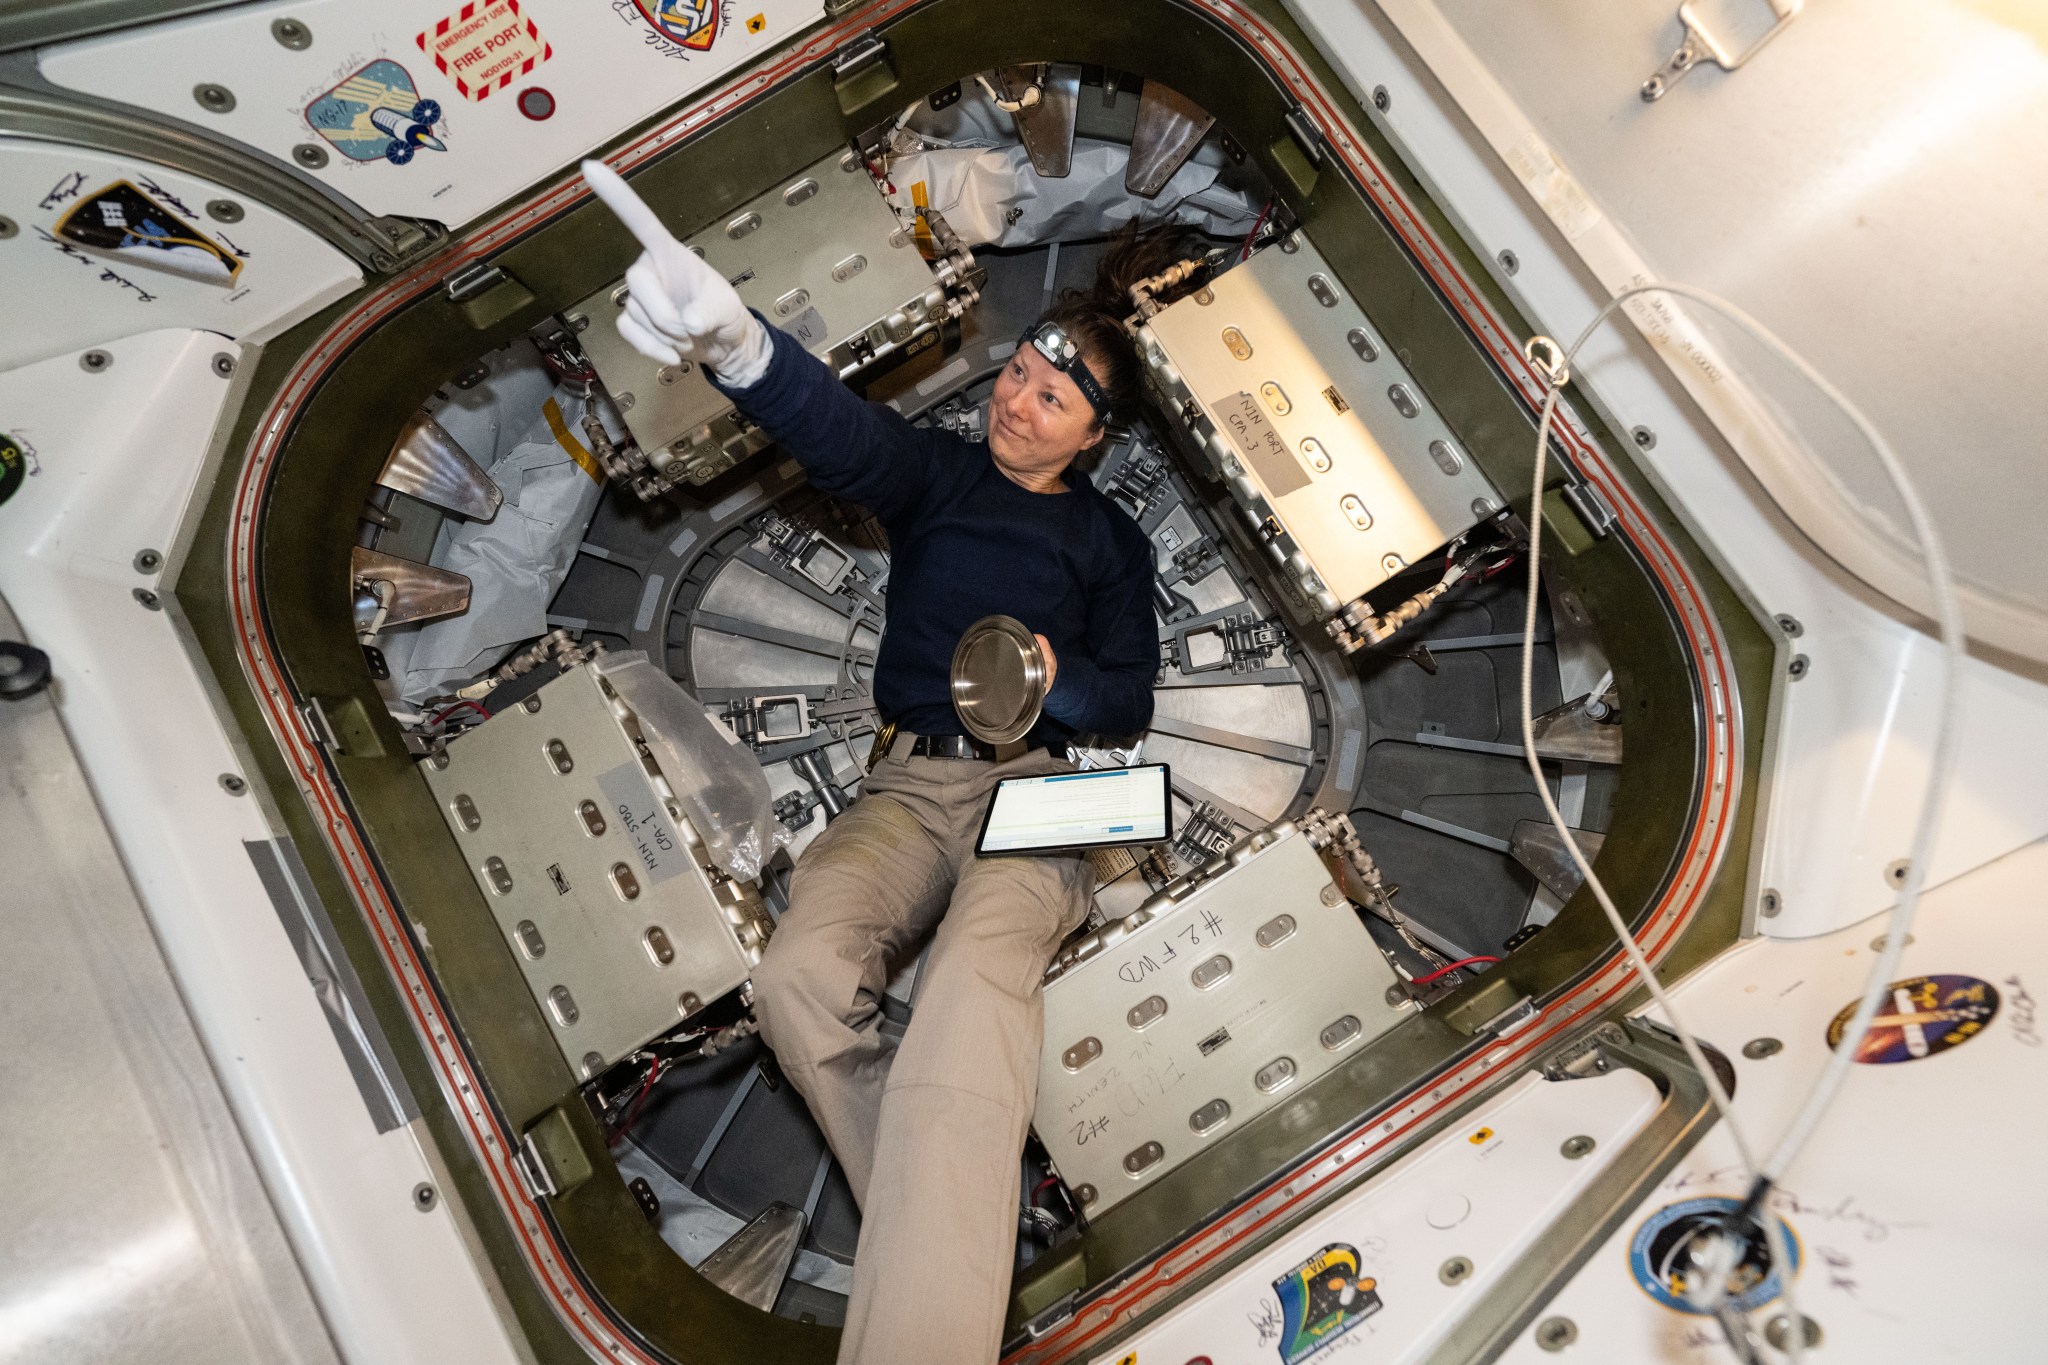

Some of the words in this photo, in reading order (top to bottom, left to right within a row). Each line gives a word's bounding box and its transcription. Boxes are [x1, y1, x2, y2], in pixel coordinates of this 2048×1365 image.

[436, 16, 489, 52] EMERGENCY
[490, 4, 508, 19] USE
[453, 46, 486, 72] FIRE
[484, 23, 522, 52] PORT
[480, 50, 525, 80] NOD1D2-31
[317, 99, 348, 127] NG-17
[1264, 431, 1285, 455] PORT
[1118, 941, 1177, 983] FWD
[1069, 1115, 1110, 1146] #2
